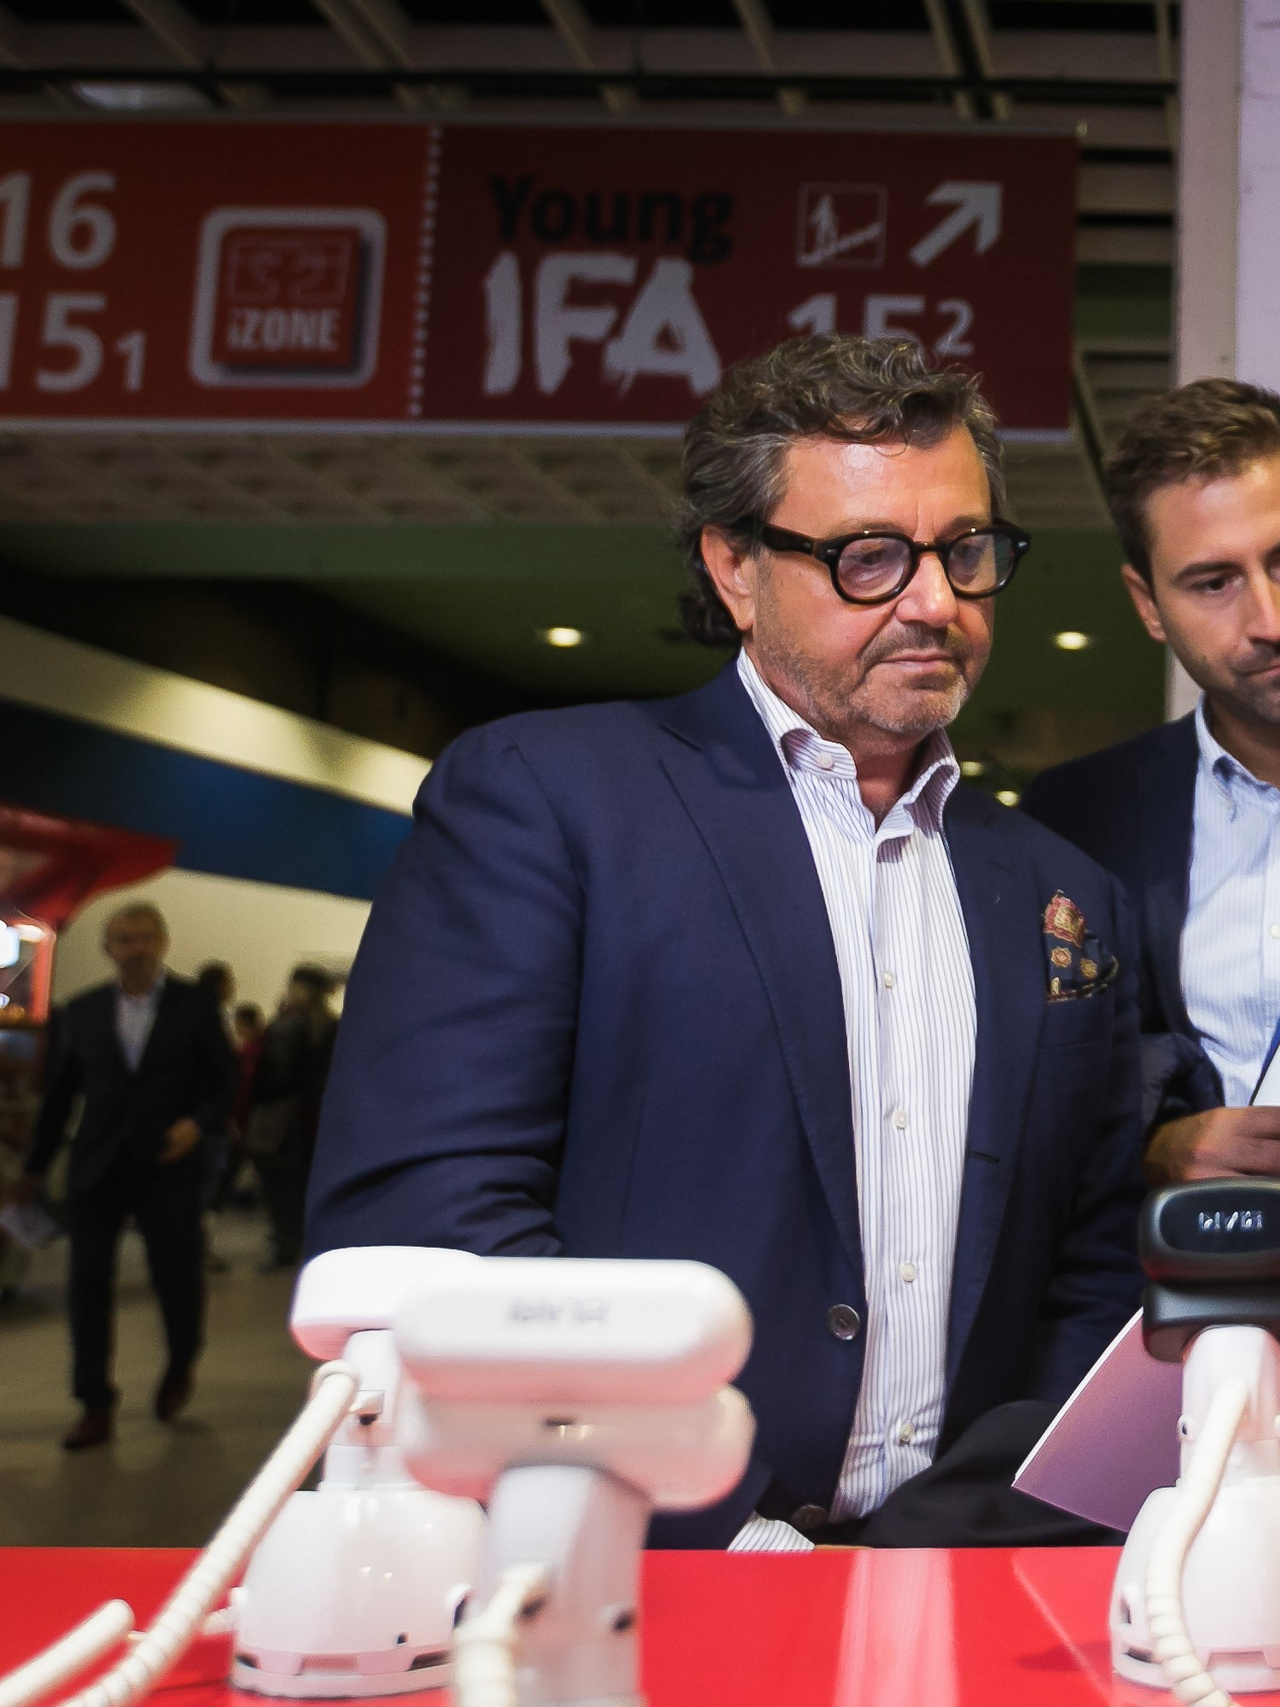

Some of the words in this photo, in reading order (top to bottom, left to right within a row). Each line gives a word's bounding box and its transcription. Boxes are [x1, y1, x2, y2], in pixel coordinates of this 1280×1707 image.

[0, 170, 118, 270] 16
[490, 175, 735, 265] Young
[483, 248, 722, 397] IFA
